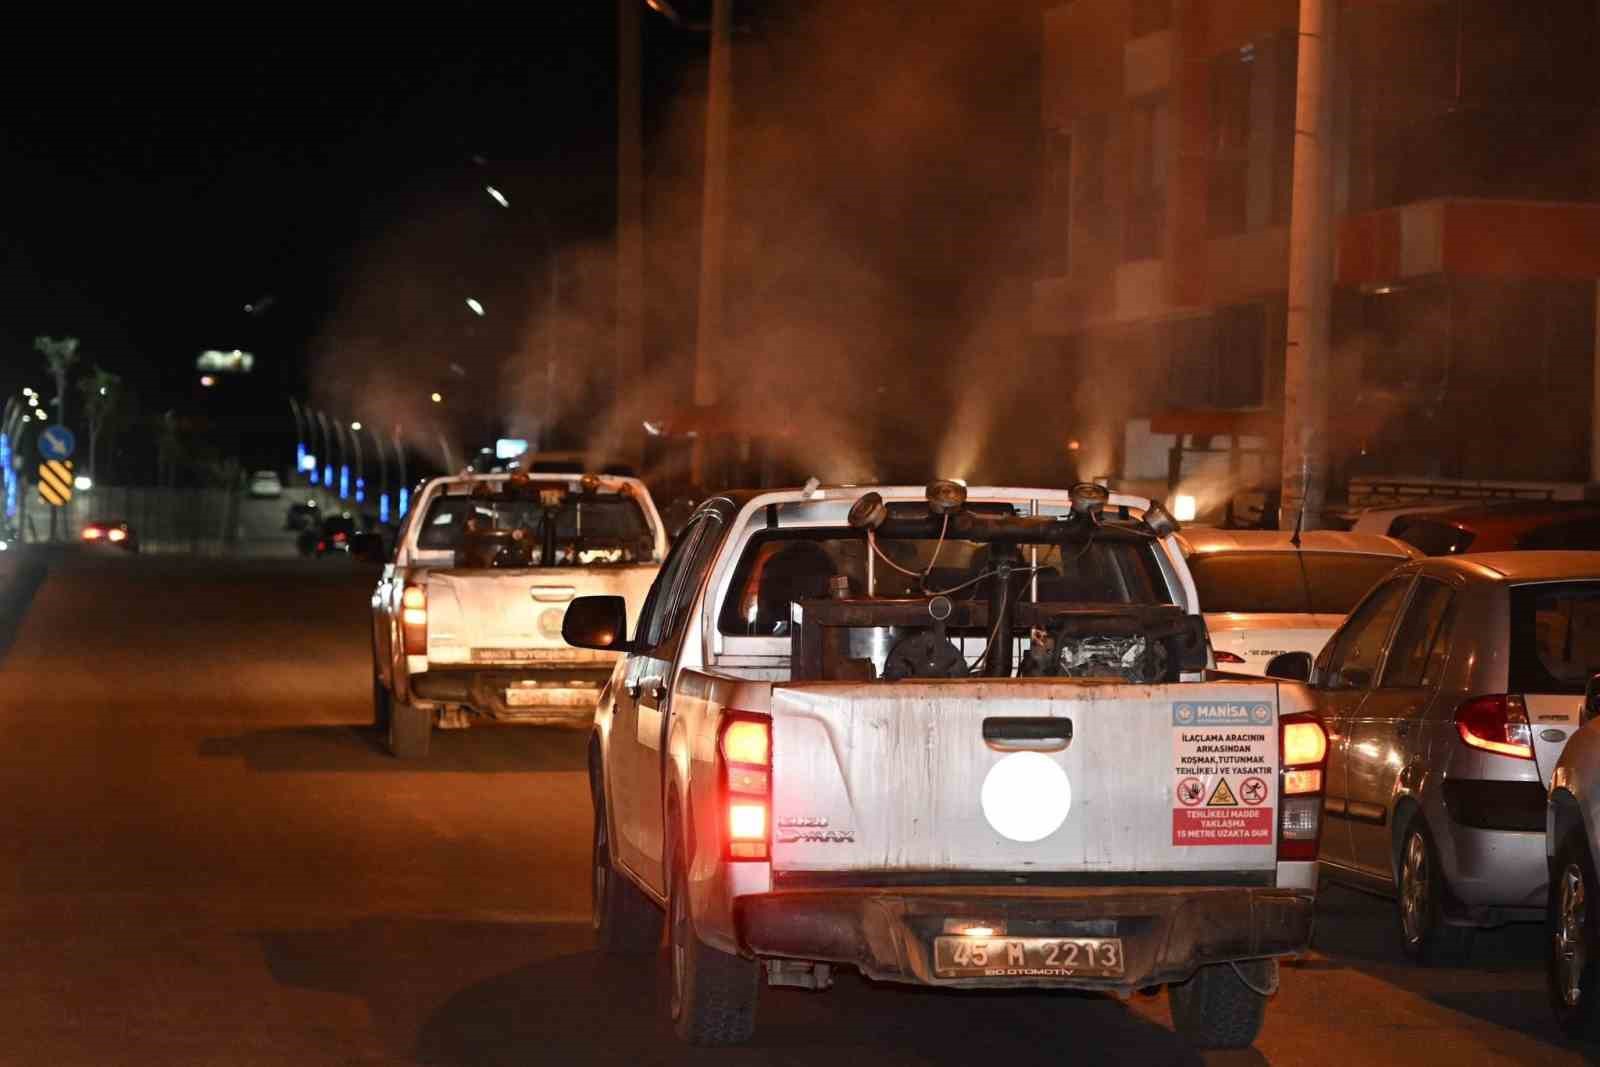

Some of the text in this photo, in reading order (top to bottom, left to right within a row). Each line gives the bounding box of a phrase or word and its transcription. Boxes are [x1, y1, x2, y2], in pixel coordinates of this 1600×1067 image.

[1197, 704, 1248, 718] MANİSA
[1182, 733, 1264, 743] İLAÇLAMA ARACININ
[1196, 745, 1251, 753] ARKASINDAN
[1176, 766, 1272, 775] TEHLİKELİ VE YASAKTIR
[1186, 810, 1260, 819] TEHLİKELİ MADDE
[1200, 819, 1245, 828] YAKLAŞMA
[1188, 830, 1216, 838] METRE
[1217, 830, 1250, 838] UZAKTA
[1251, 830, 1268, 838] DUR
[953, 942, 1118, 967] 45 M 2213
